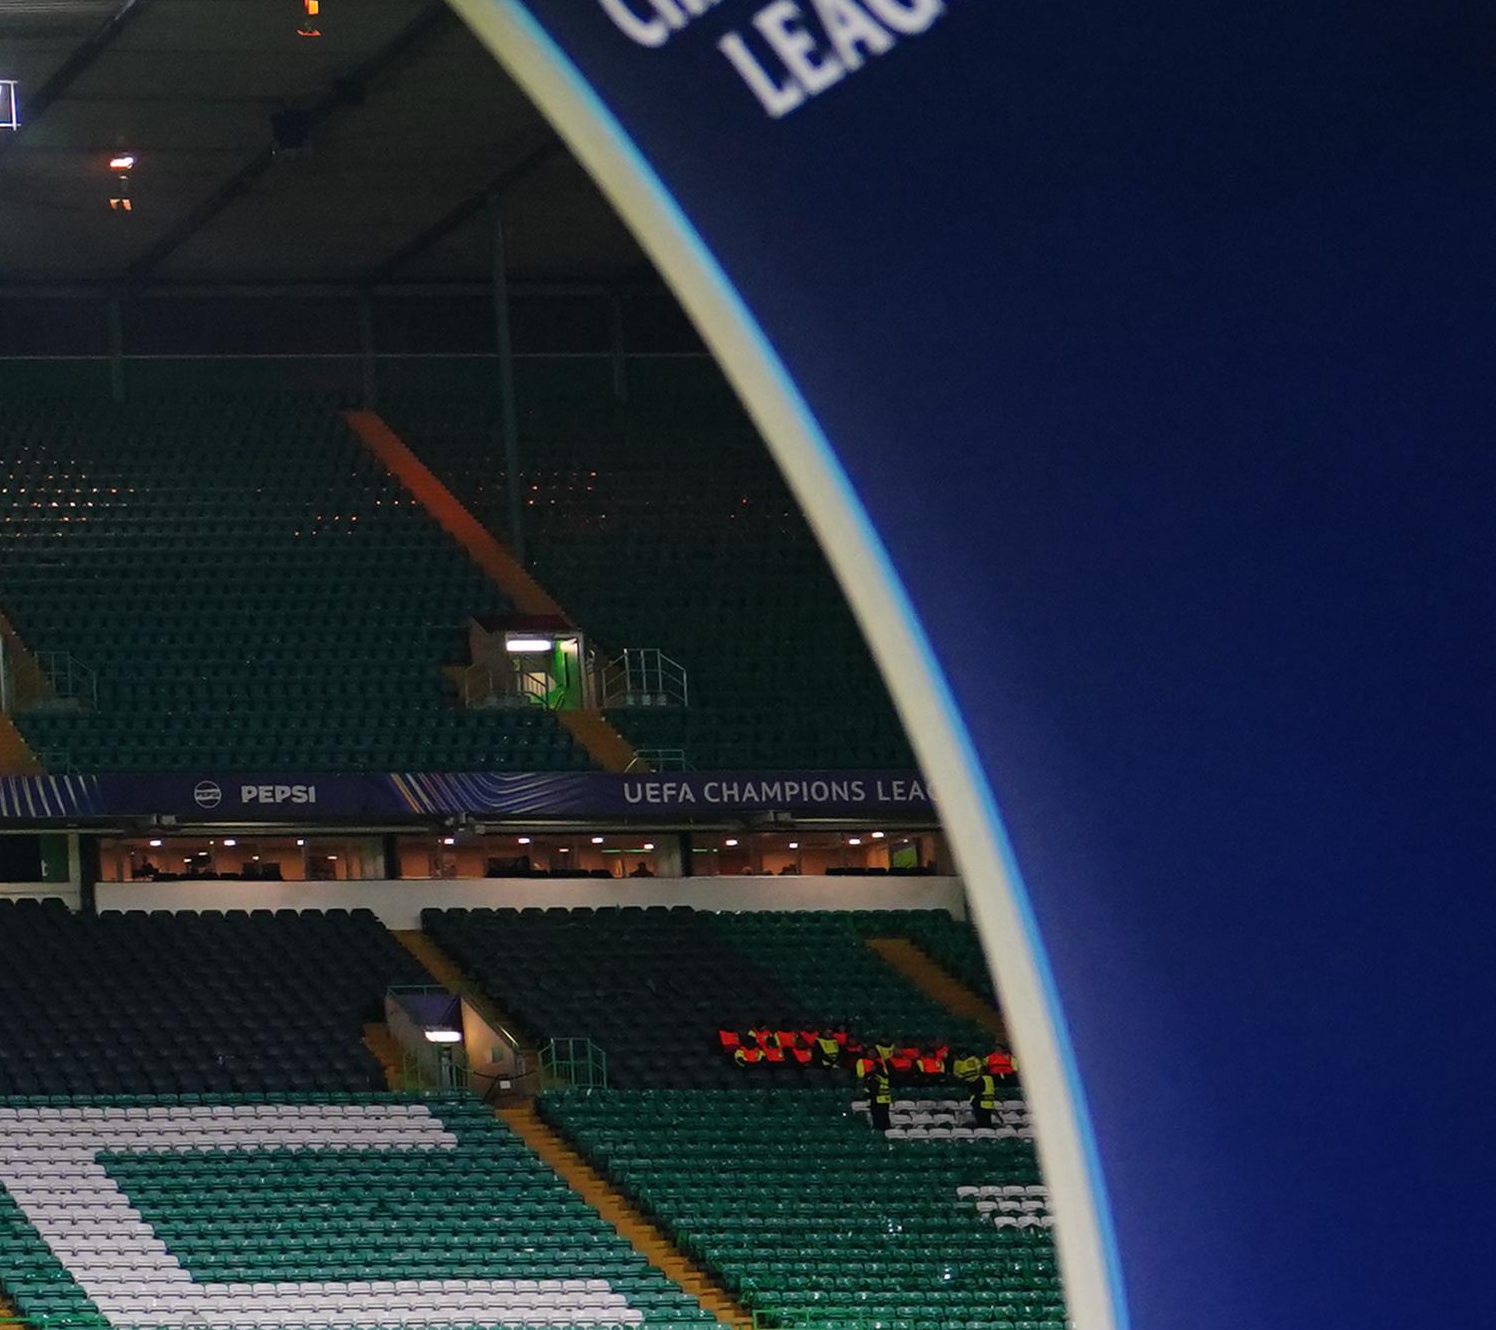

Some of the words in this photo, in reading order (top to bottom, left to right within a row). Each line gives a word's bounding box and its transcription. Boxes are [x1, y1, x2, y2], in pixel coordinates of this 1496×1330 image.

[241, 785, 316, 804] PEPSI
[623, 782, 696, 805] UEFA
[703, 781, 866, 803] CHAMPIONS
